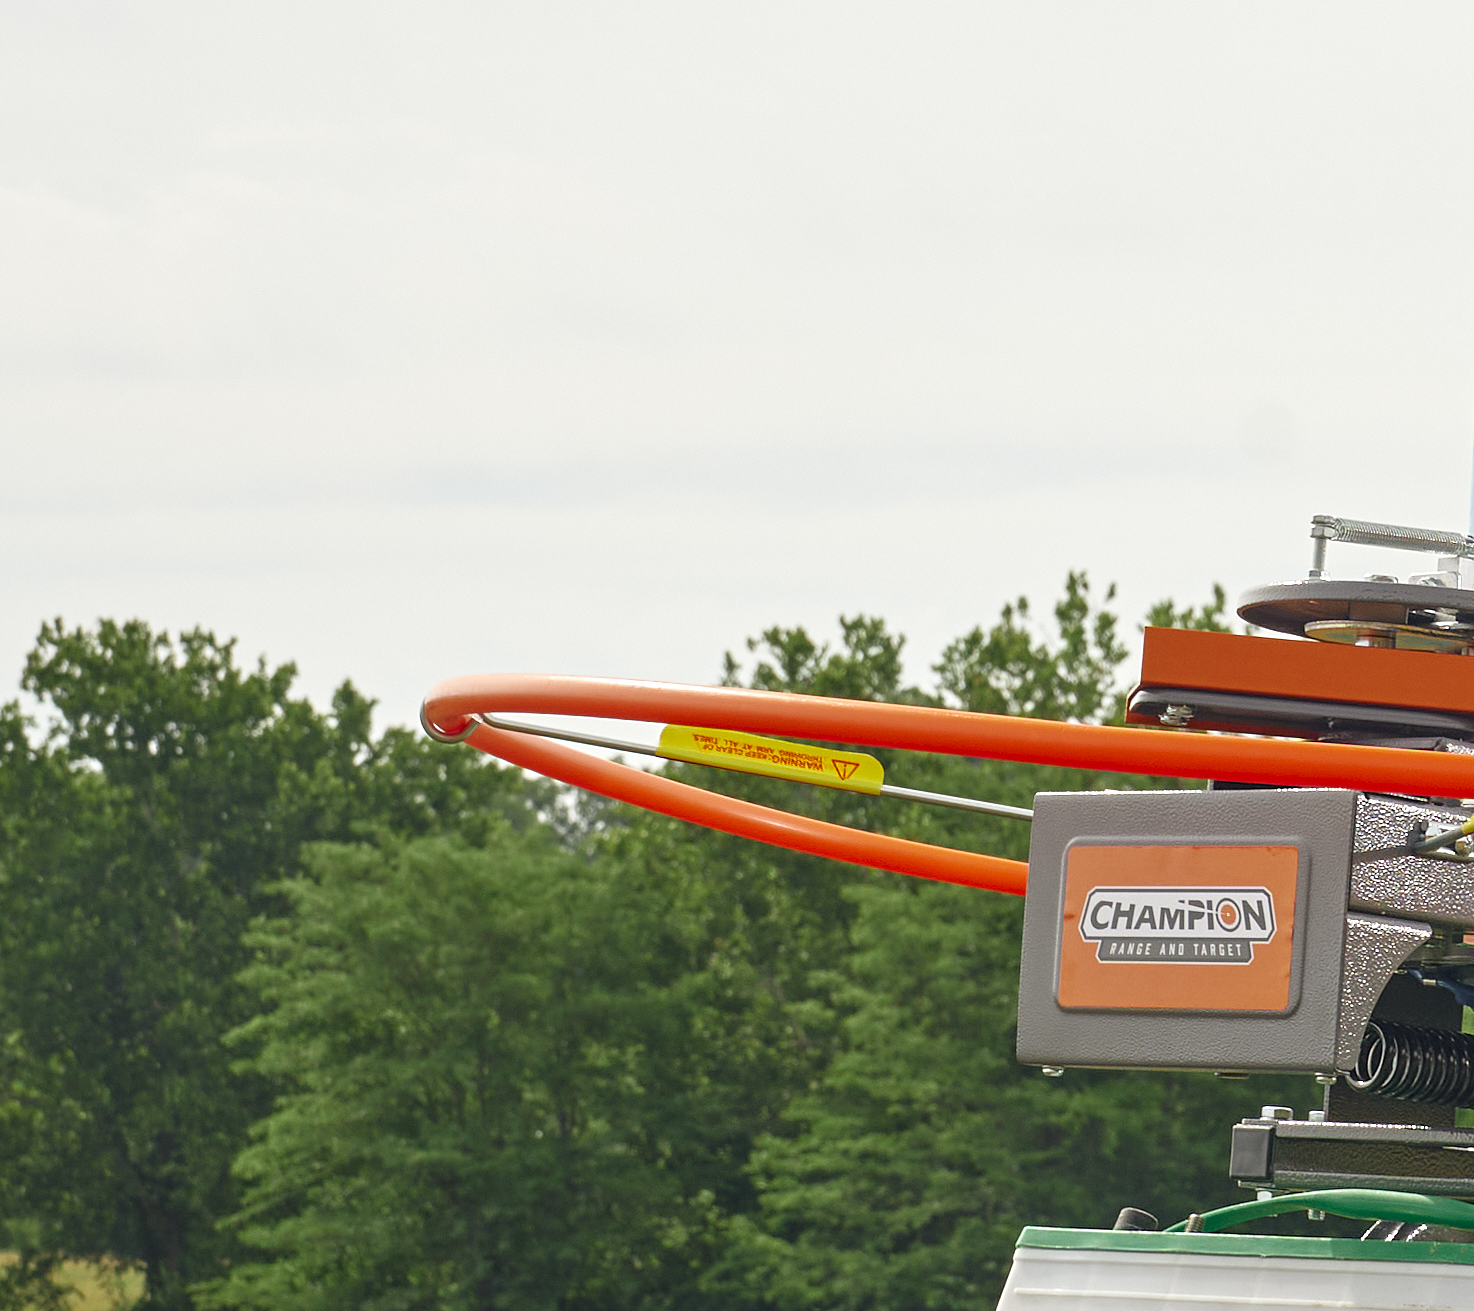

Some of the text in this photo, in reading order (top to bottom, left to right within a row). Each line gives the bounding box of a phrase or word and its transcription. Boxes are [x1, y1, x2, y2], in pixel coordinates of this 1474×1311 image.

[692, 734, 823, 763] THROWING ARM AT ALL TIMES
[703, 743, 714, 751] OF
[716, 745, 743, 756] CLEAR
[745, 751, 768, 760] KEEP
[1090, 898, 1267, 932] CHAMPION
[1110, 943, 1242, 956] RANGE AND TARGET
